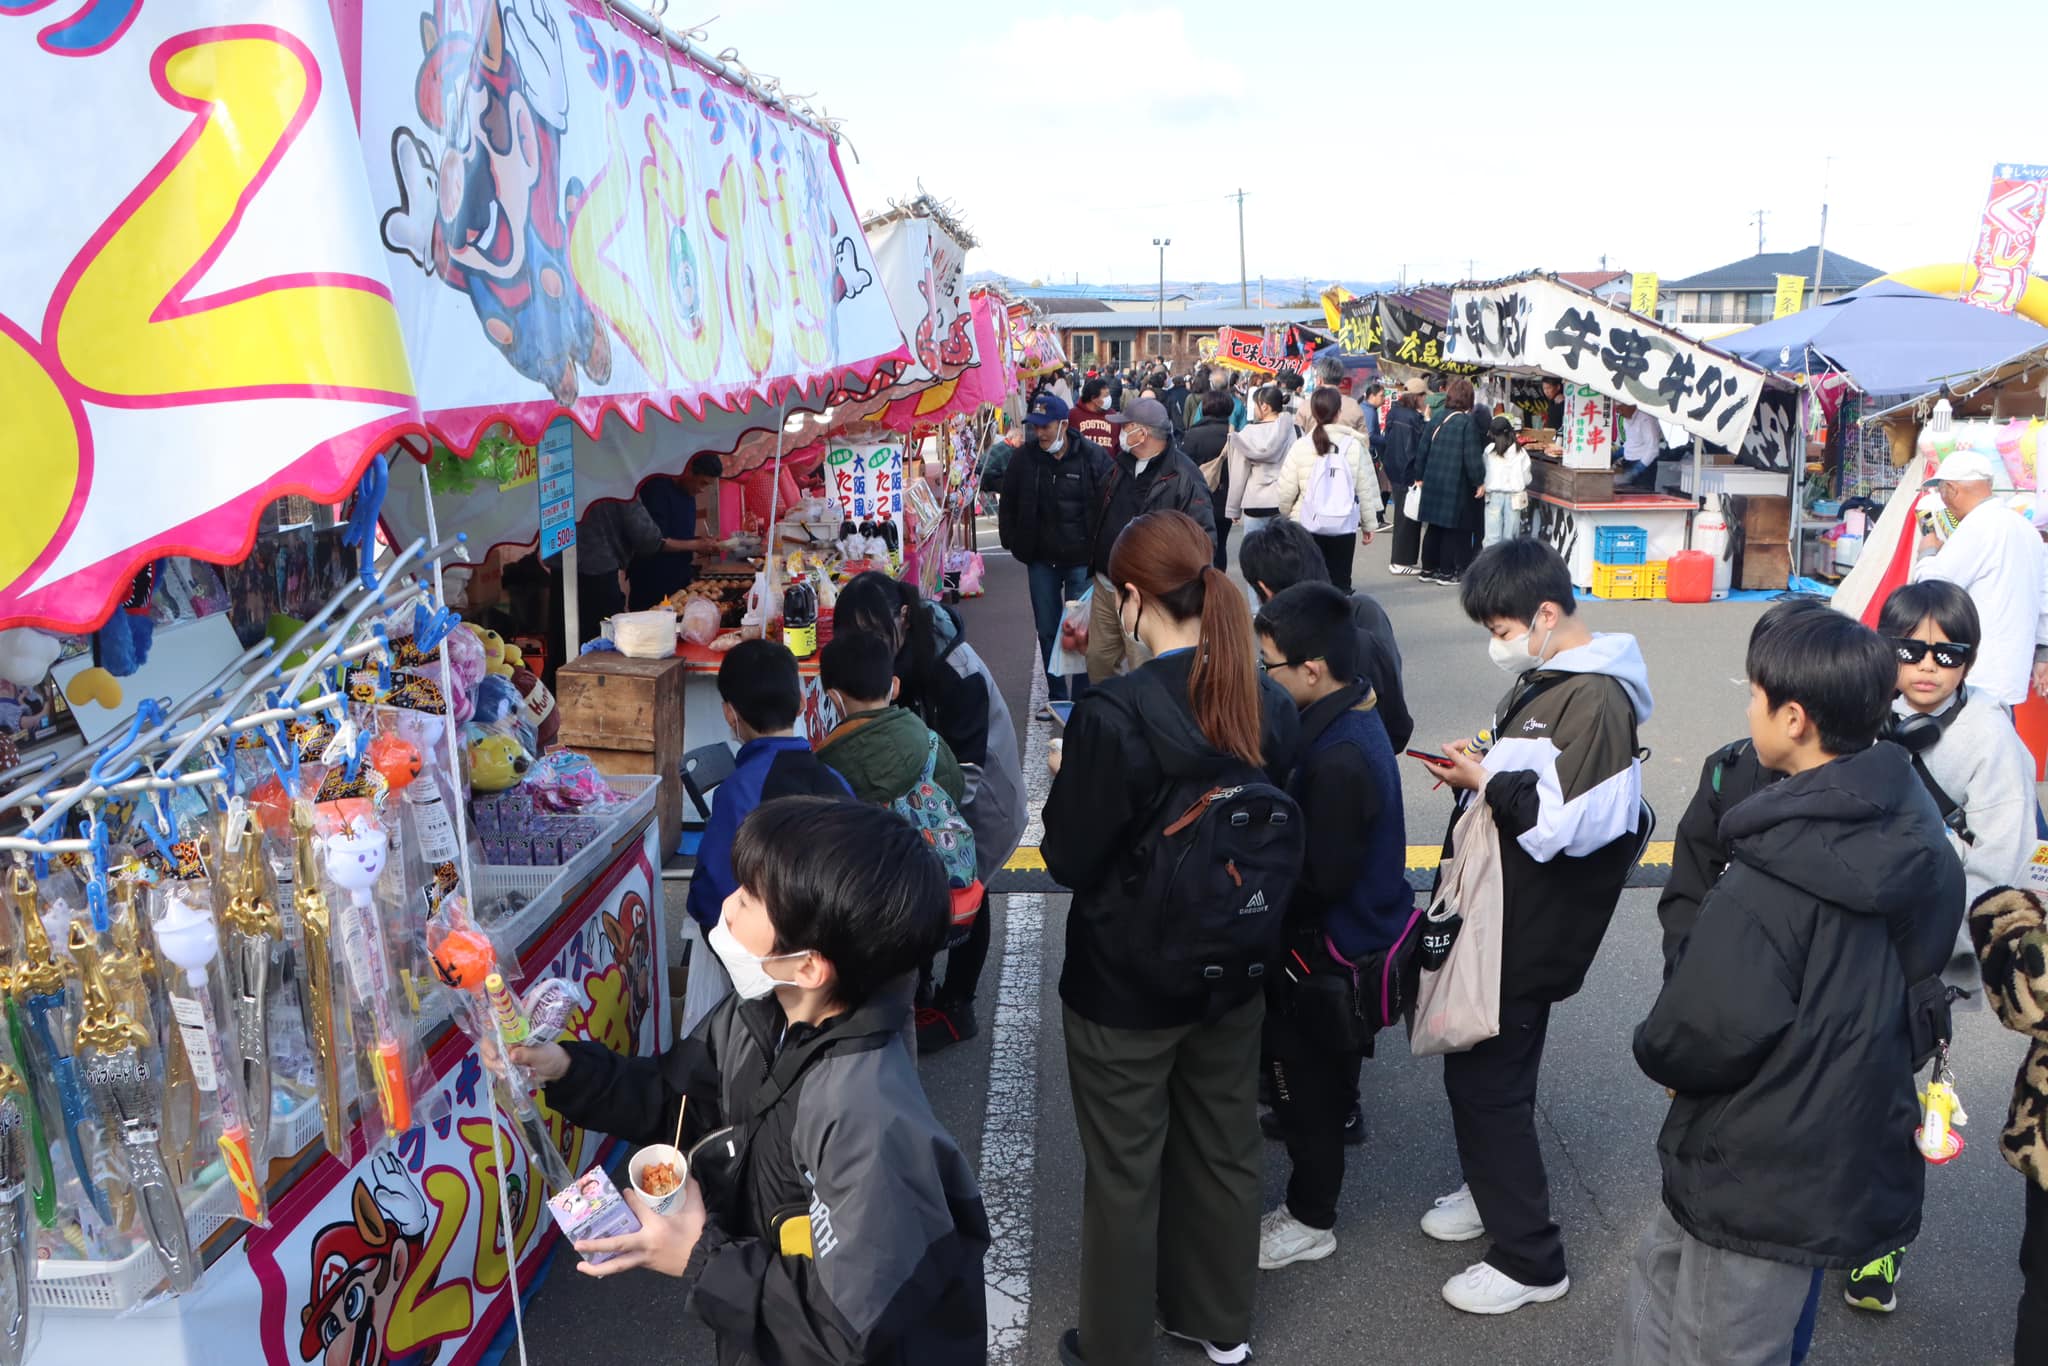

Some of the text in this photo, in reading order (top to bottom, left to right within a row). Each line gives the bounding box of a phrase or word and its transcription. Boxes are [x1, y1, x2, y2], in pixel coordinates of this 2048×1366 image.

[1080, 419, 1111, 434] BOSTON
[1581, 400, 1606, 454] 牛串
[853, 453, 866, 517] 大阪風
[890, 450, 902, 512] 大阪風
